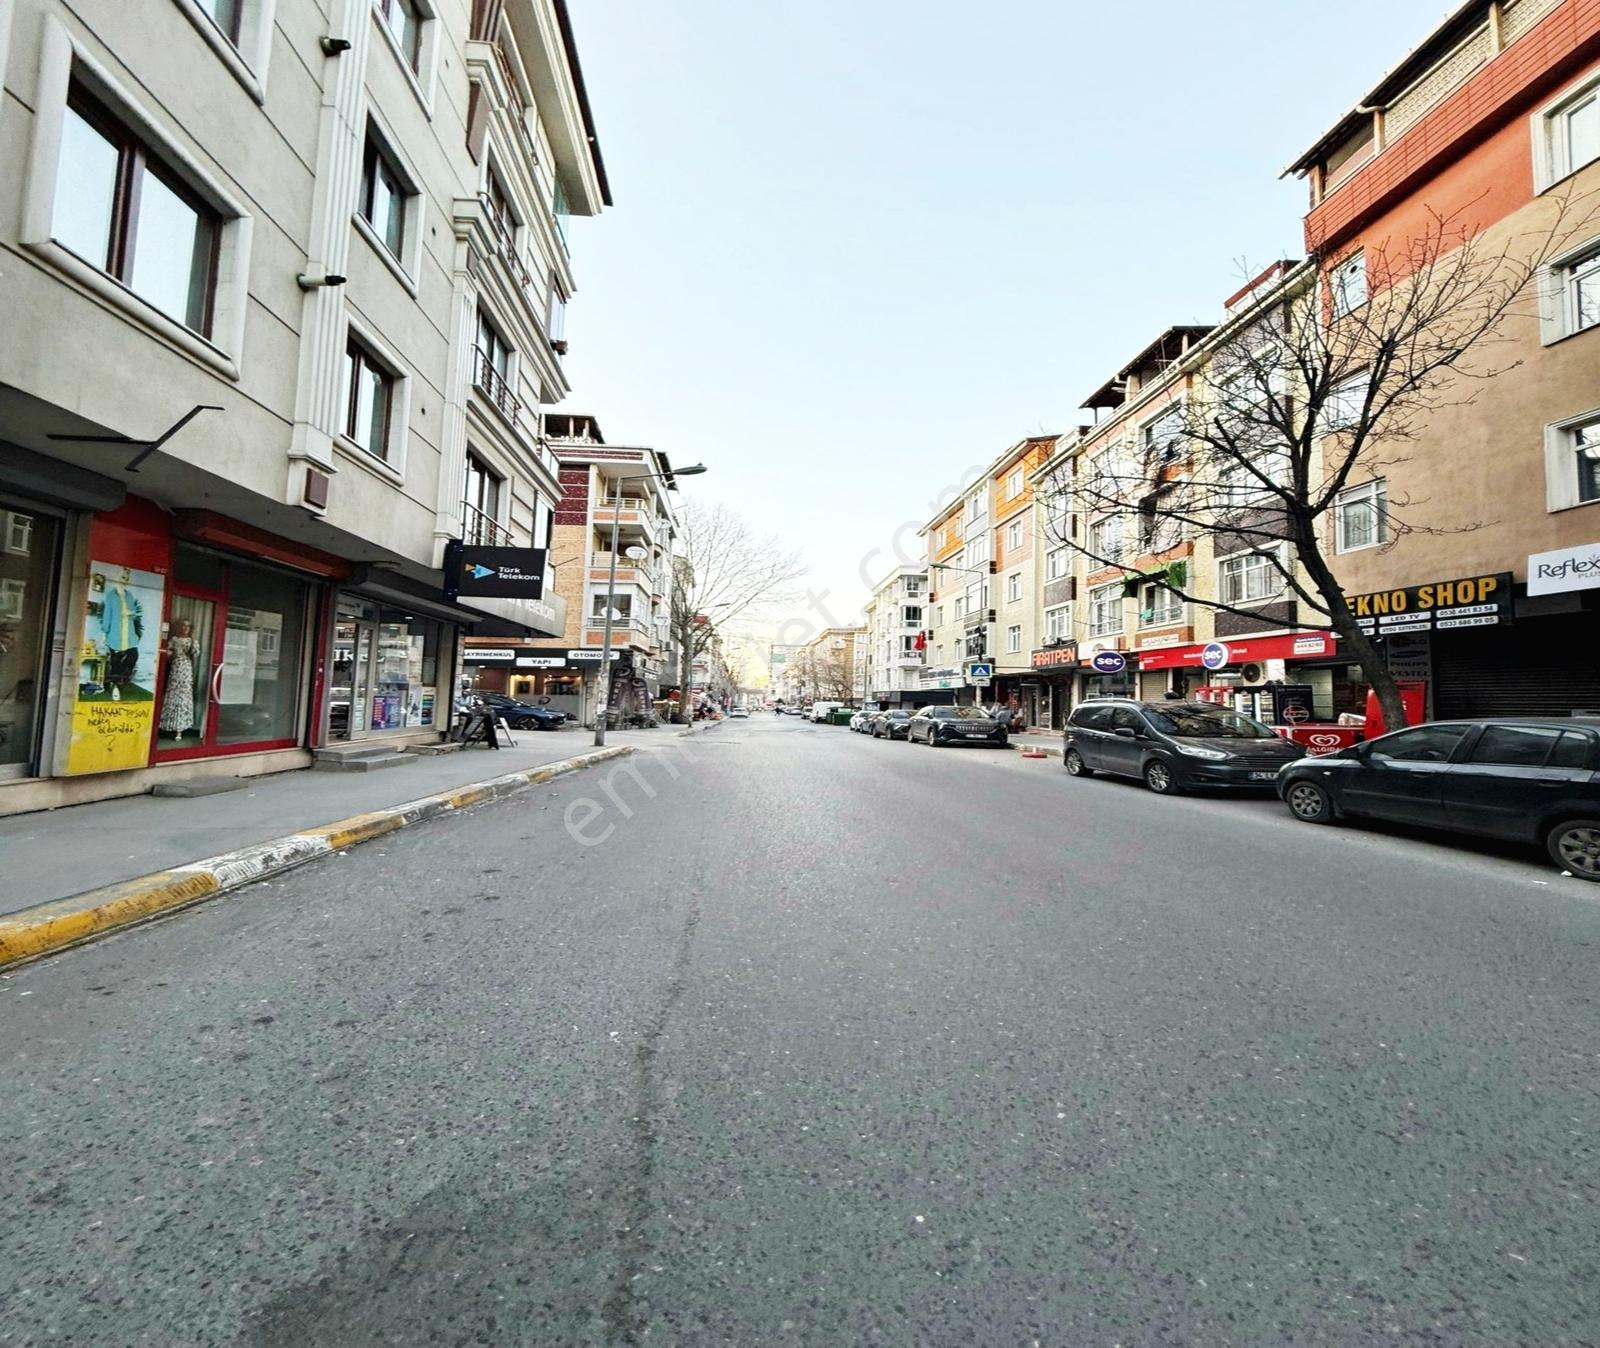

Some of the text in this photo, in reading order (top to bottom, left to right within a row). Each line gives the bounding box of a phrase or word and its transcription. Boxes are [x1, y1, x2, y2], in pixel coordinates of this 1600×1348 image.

[498, 572, 541, 580] Telekom
[1538, 557, 1600, 579] Reflex
[1345, 577, 1498, 617] EKNO SHOP
[1032, 647, 1076, 667] FIRATPEN
